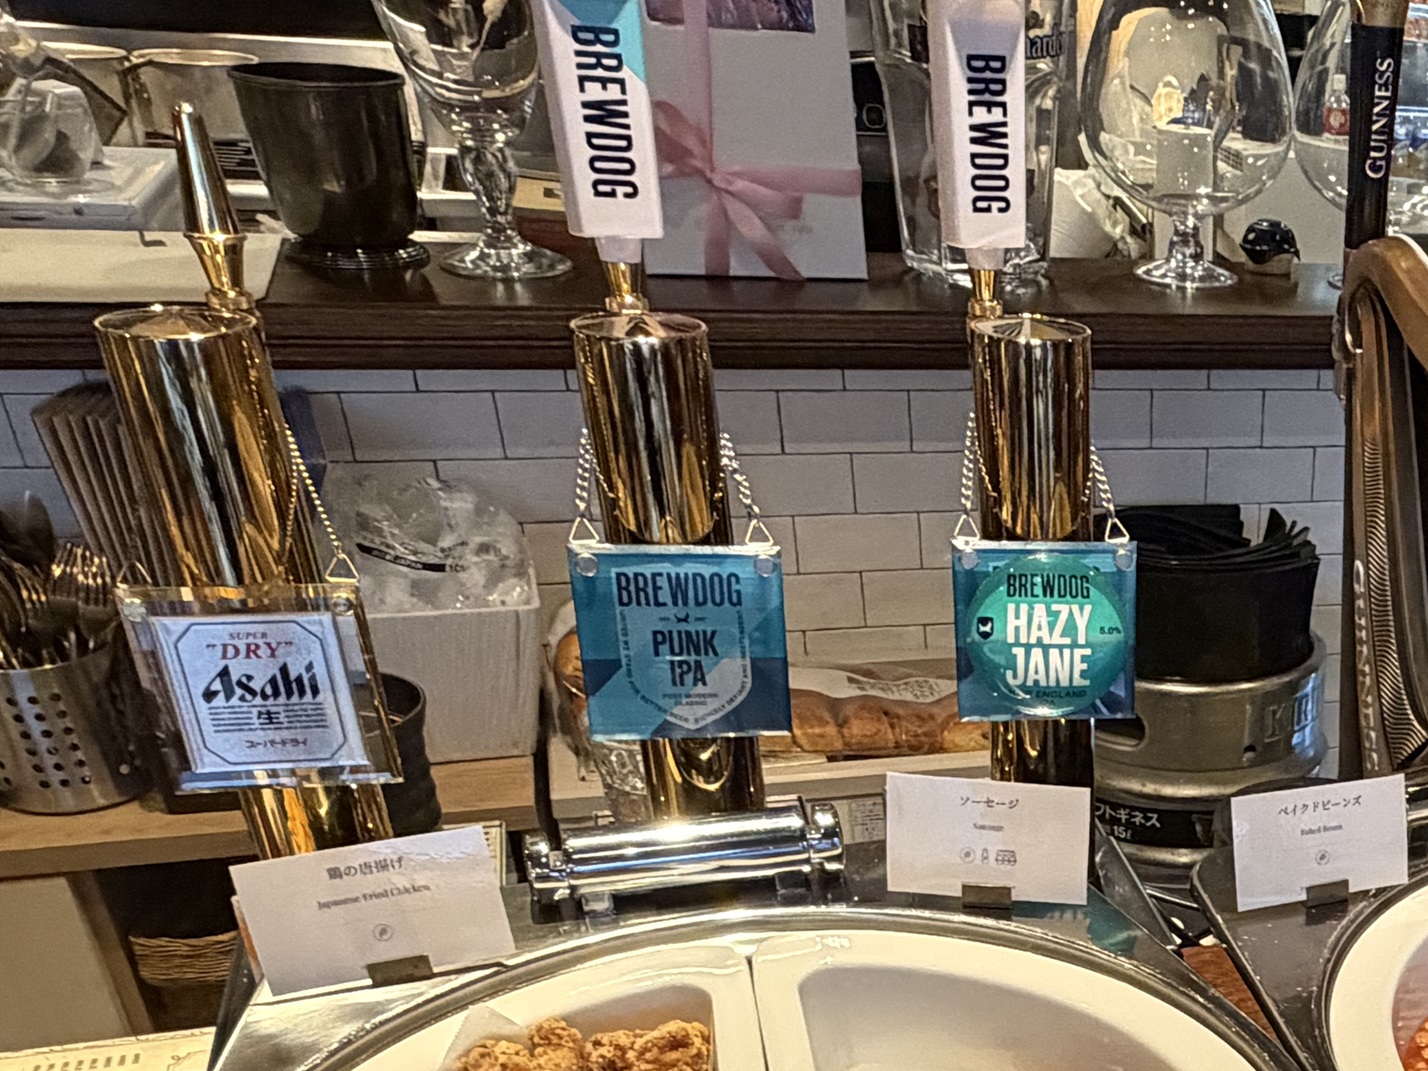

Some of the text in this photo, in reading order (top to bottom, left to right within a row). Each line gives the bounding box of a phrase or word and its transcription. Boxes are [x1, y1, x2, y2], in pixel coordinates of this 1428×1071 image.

[571, 24, 639, 199] BREWDOG
[1365, 57, 1394, 179] GUINNESS
[966, 54, 1011, 214] BREWDOG
[615, 572, 743, 607] BREWDOG
[1006, 573, 1091, 599] BREWDOG
[228, 631, 269, 641] SUPER
[1006, 603, 1092, 645] HAZY
[652, 629, 720, 657] PUNK
[202, 660, 321, 704] Asahi
[668, 660, 708, 687] IPA
[1005, 647, 1092, 687] JANE
[1035, 690, 1087, 698] ENGLAND
[257, 710, 285, 726] 生
[960, 796, 1019, 809] ソーセージ
